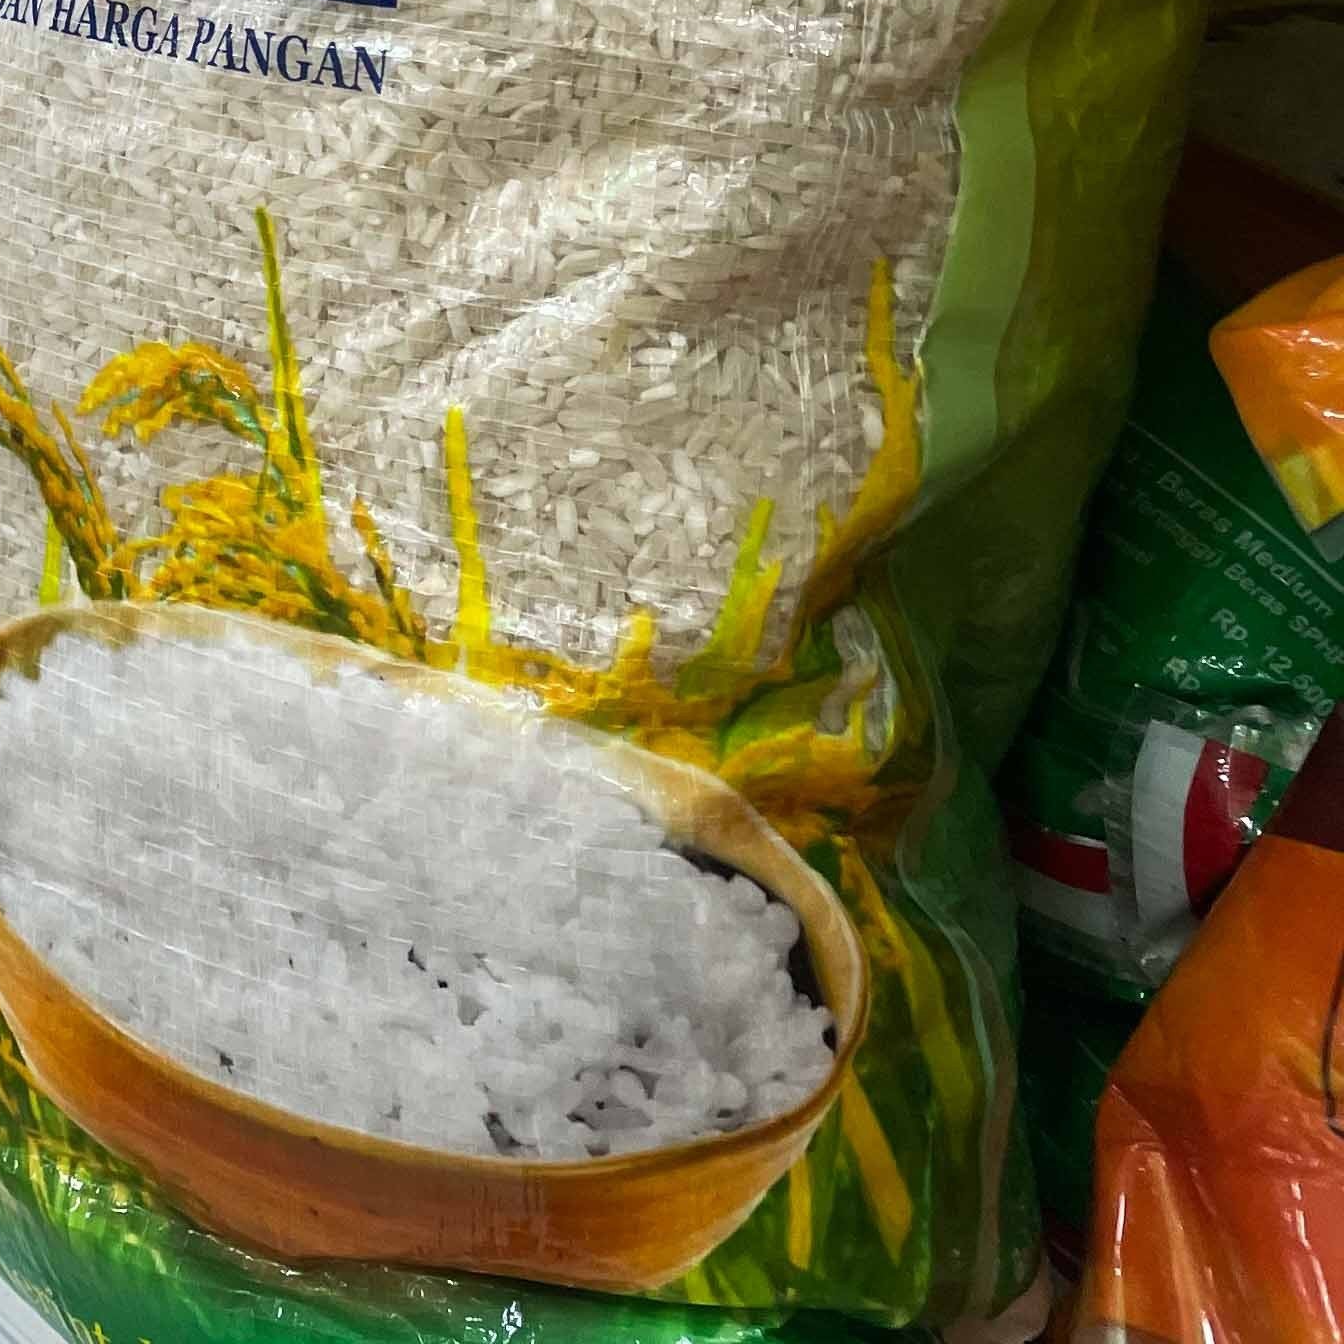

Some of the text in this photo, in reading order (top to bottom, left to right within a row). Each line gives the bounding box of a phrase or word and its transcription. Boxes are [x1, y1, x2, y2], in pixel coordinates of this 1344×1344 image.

[184, 16, 388, 95] PANGAN
[1223, 562, 1289, 617] Beras
[1233, 529, 1335, 618] Medium
